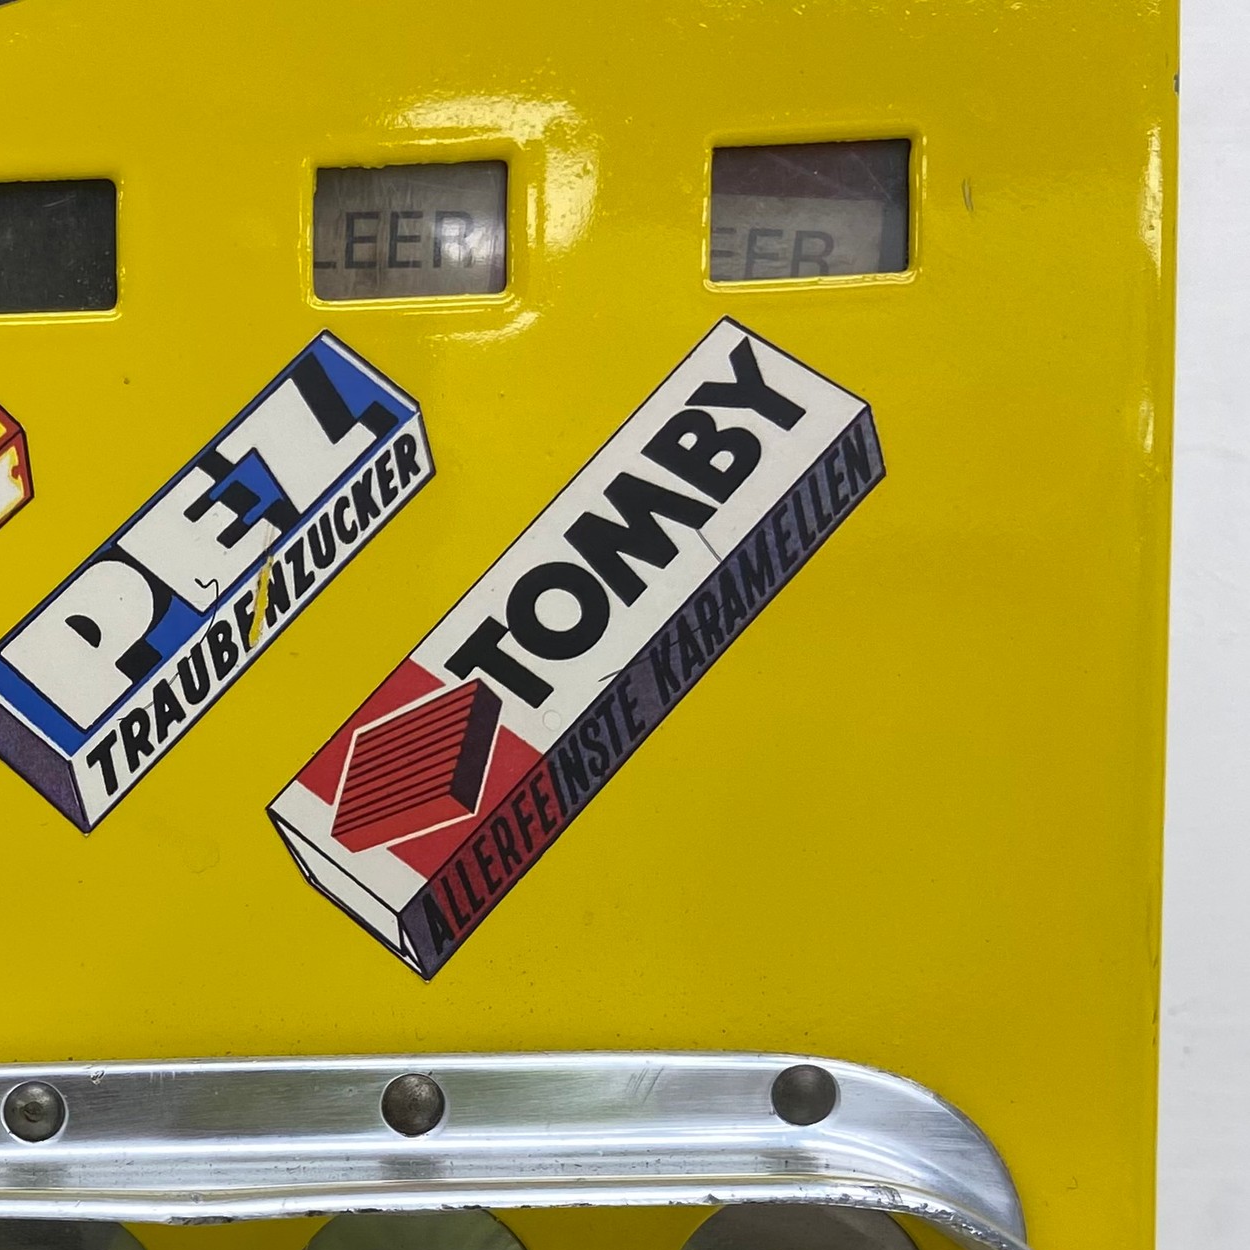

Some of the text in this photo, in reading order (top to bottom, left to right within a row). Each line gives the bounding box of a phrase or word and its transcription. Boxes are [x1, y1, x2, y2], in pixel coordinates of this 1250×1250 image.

[0, 376, 380, 730] PEZ
[421, 424, 872, 955] ALLERFEINSTE KARAMELLEN
[443, 337, 805, 708] TOMBY
